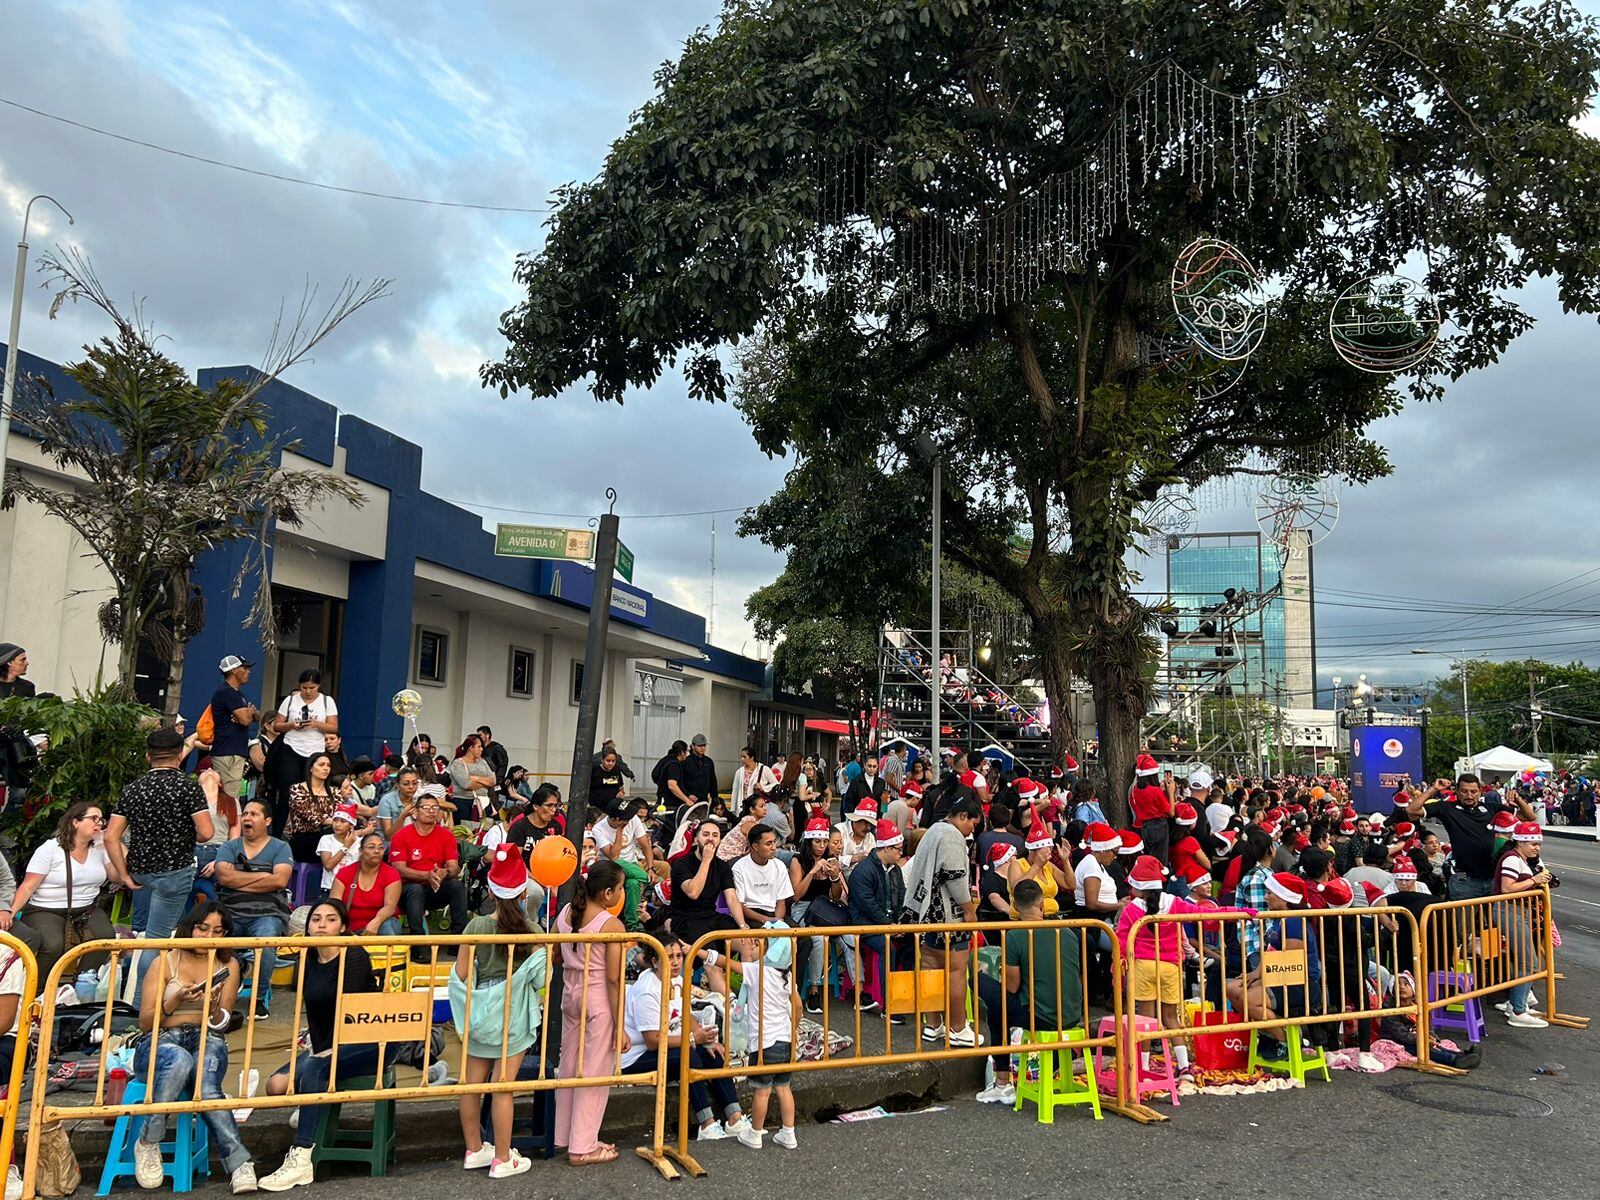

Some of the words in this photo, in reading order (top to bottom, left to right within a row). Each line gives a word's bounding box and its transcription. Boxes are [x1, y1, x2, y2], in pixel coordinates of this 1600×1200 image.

[508, 536, 549, 549] AVENIDA
[549, 539, 556, 549] 0
[612, 594, 626, 605] BANCO
[627, 599, 645, 612] NACIONAL
[1272, 964, 1303, 973] RAHSO
[357, 1012, 423, 1024] RAHSO
